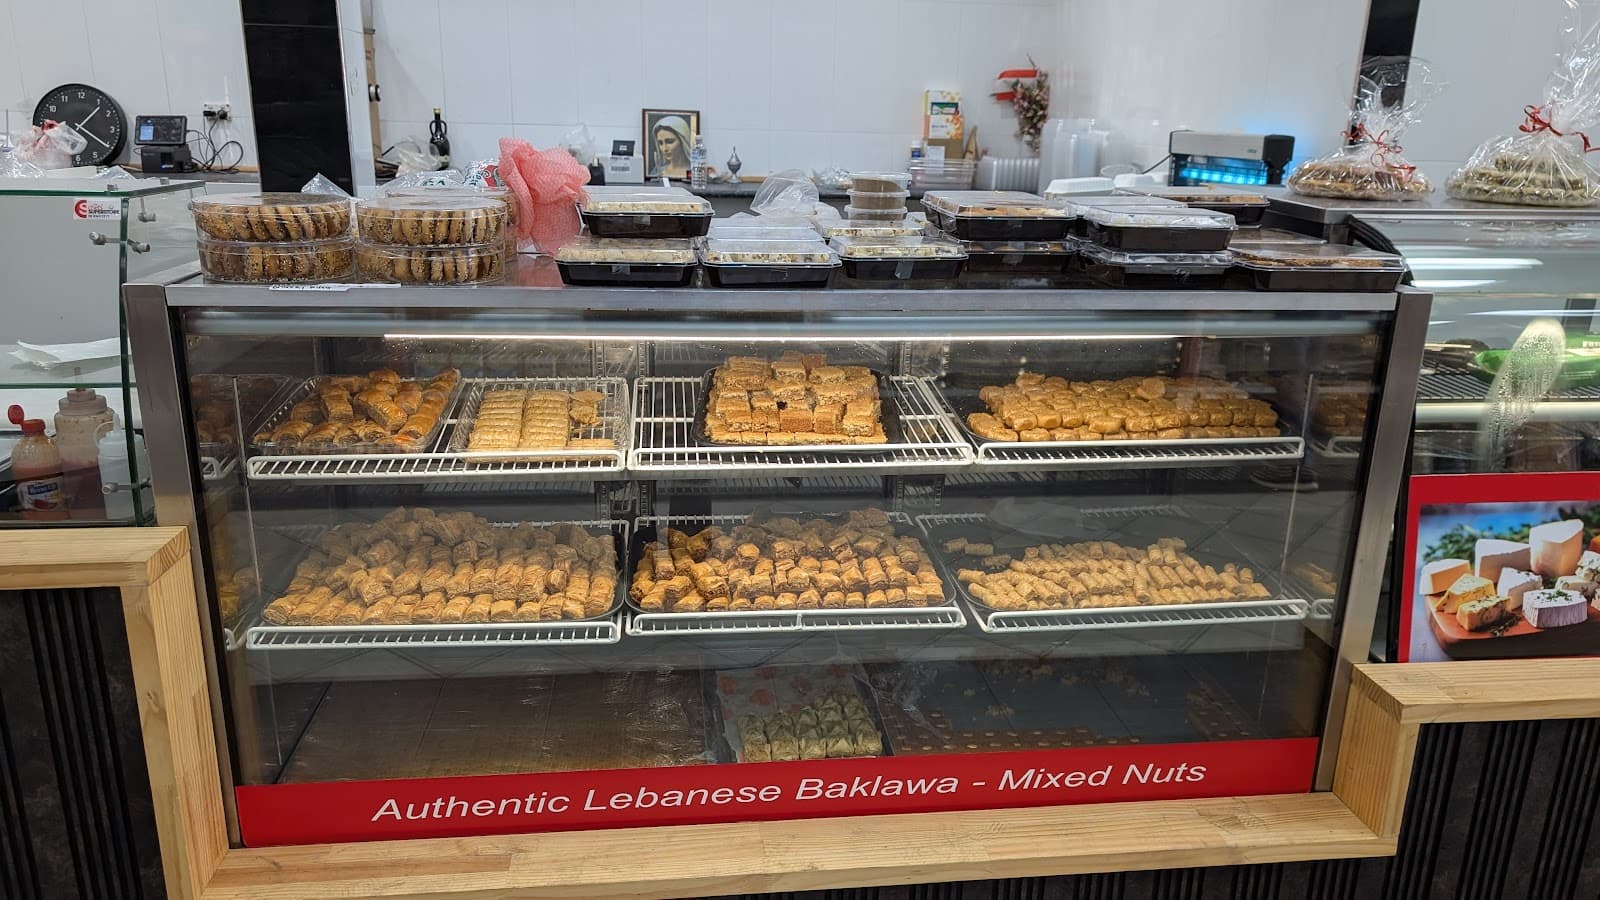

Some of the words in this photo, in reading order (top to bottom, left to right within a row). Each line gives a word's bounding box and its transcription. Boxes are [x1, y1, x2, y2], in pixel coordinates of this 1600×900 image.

[49, 105, 57, 113] 10
[75, 154, 81, 162] 6
[371, 793, 570, 822] Authentic
[583, 786, 782, 811] Lebanese
[795, 776, 959, 800] Baklawa
[998, 765, 1113, 791] Mixed
[1121, 762, 1207, 785] Nuts
